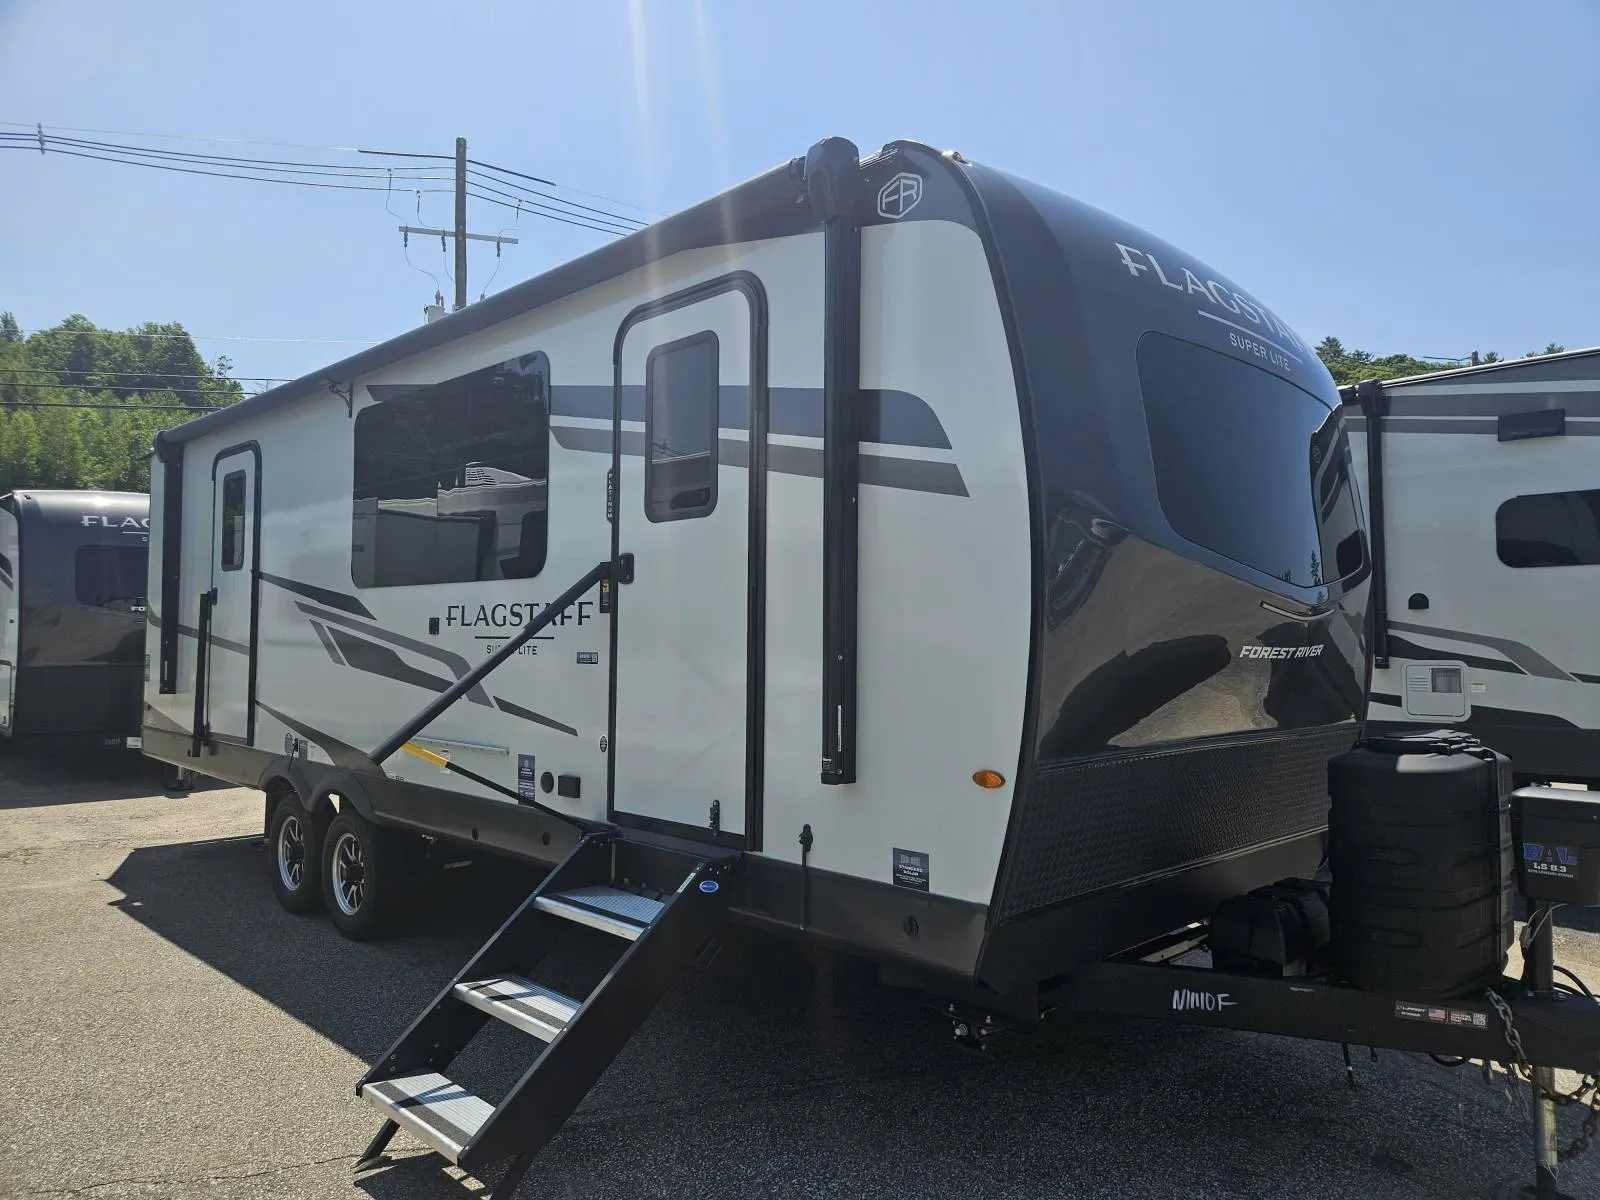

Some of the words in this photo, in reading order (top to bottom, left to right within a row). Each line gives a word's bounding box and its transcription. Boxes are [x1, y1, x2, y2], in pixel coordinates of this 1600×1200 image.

[1229, 332, 1268, 357] SUPER
[1269, 350, 1292, 372] LITE
[518, 645, 538, 656] LITE
[1239, 645, 1296, 659] FOREST
[1294, 644, 1325, 659] RIVER
[1533, 862, 1548, 871] LS
